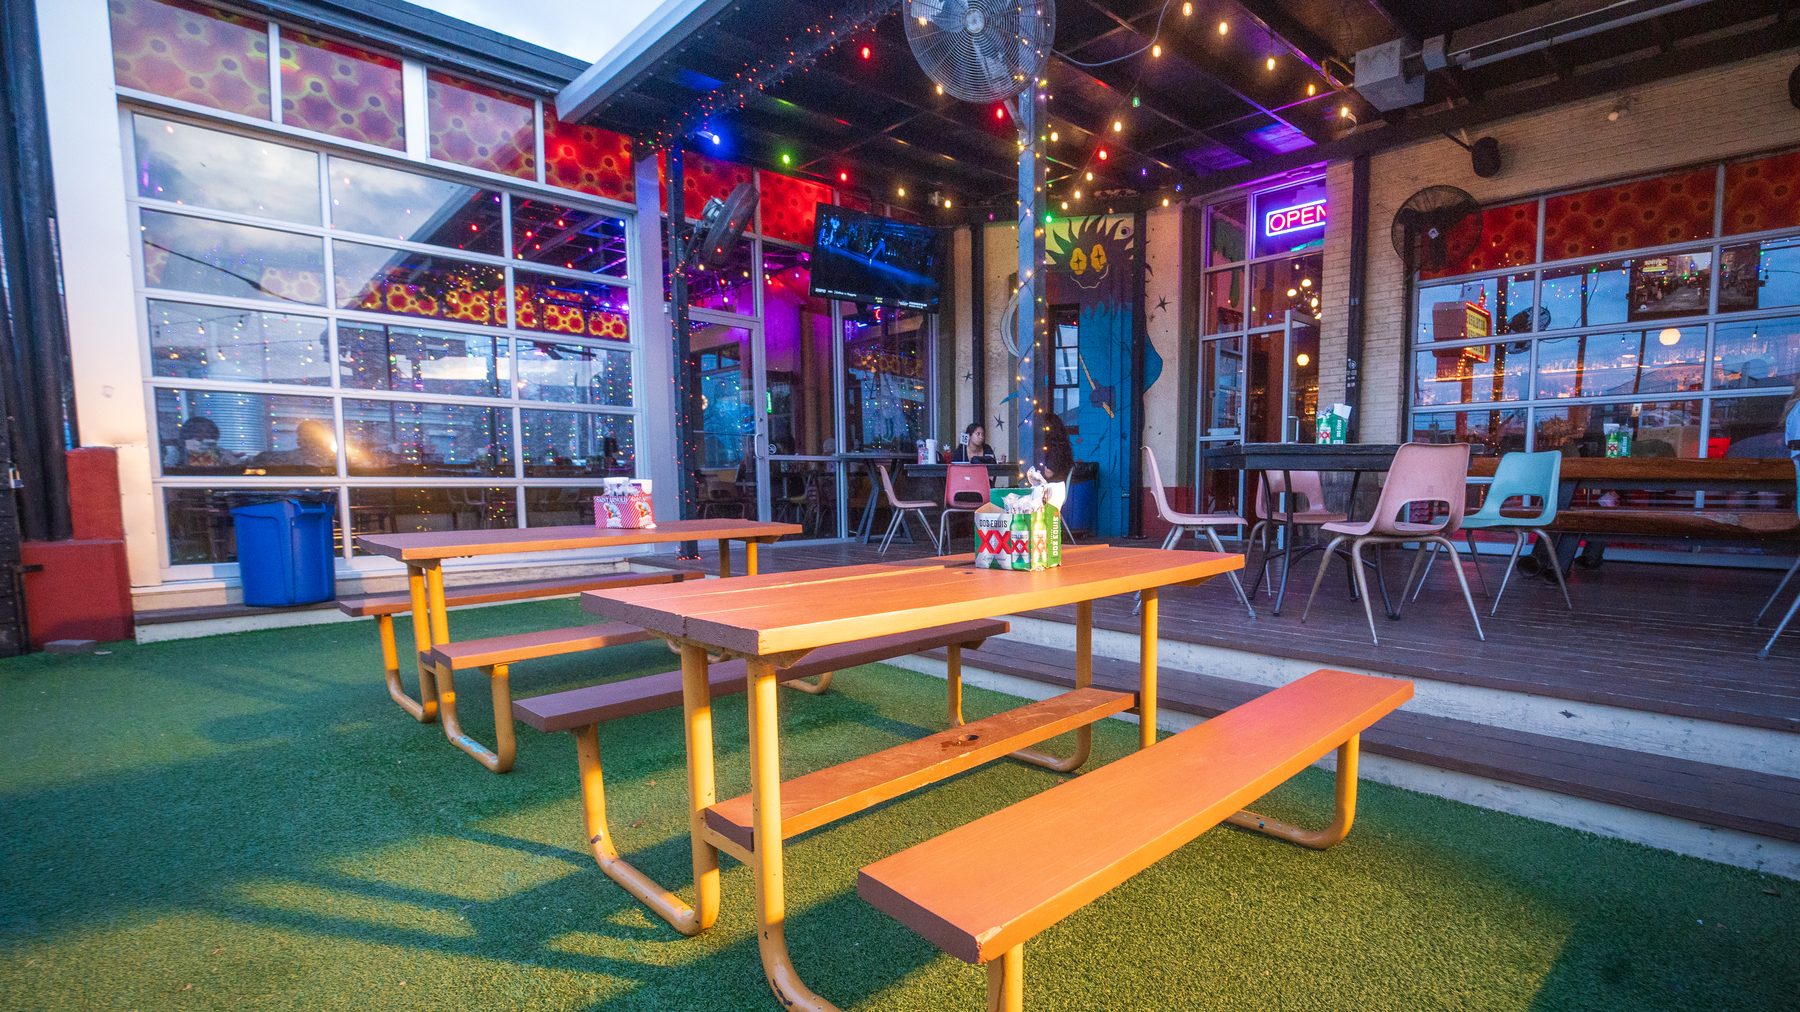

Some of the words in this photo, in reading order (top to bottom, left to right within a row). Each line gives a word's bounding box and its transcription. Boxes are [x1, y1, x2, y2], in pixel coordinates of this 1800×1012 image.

[1270, 205, 1326, 231] OPEN
[990, 519, 1008, 528] EQUIS
[977, 530, 1011, 554] XX
[1011, 540, 1029, 553] XX
